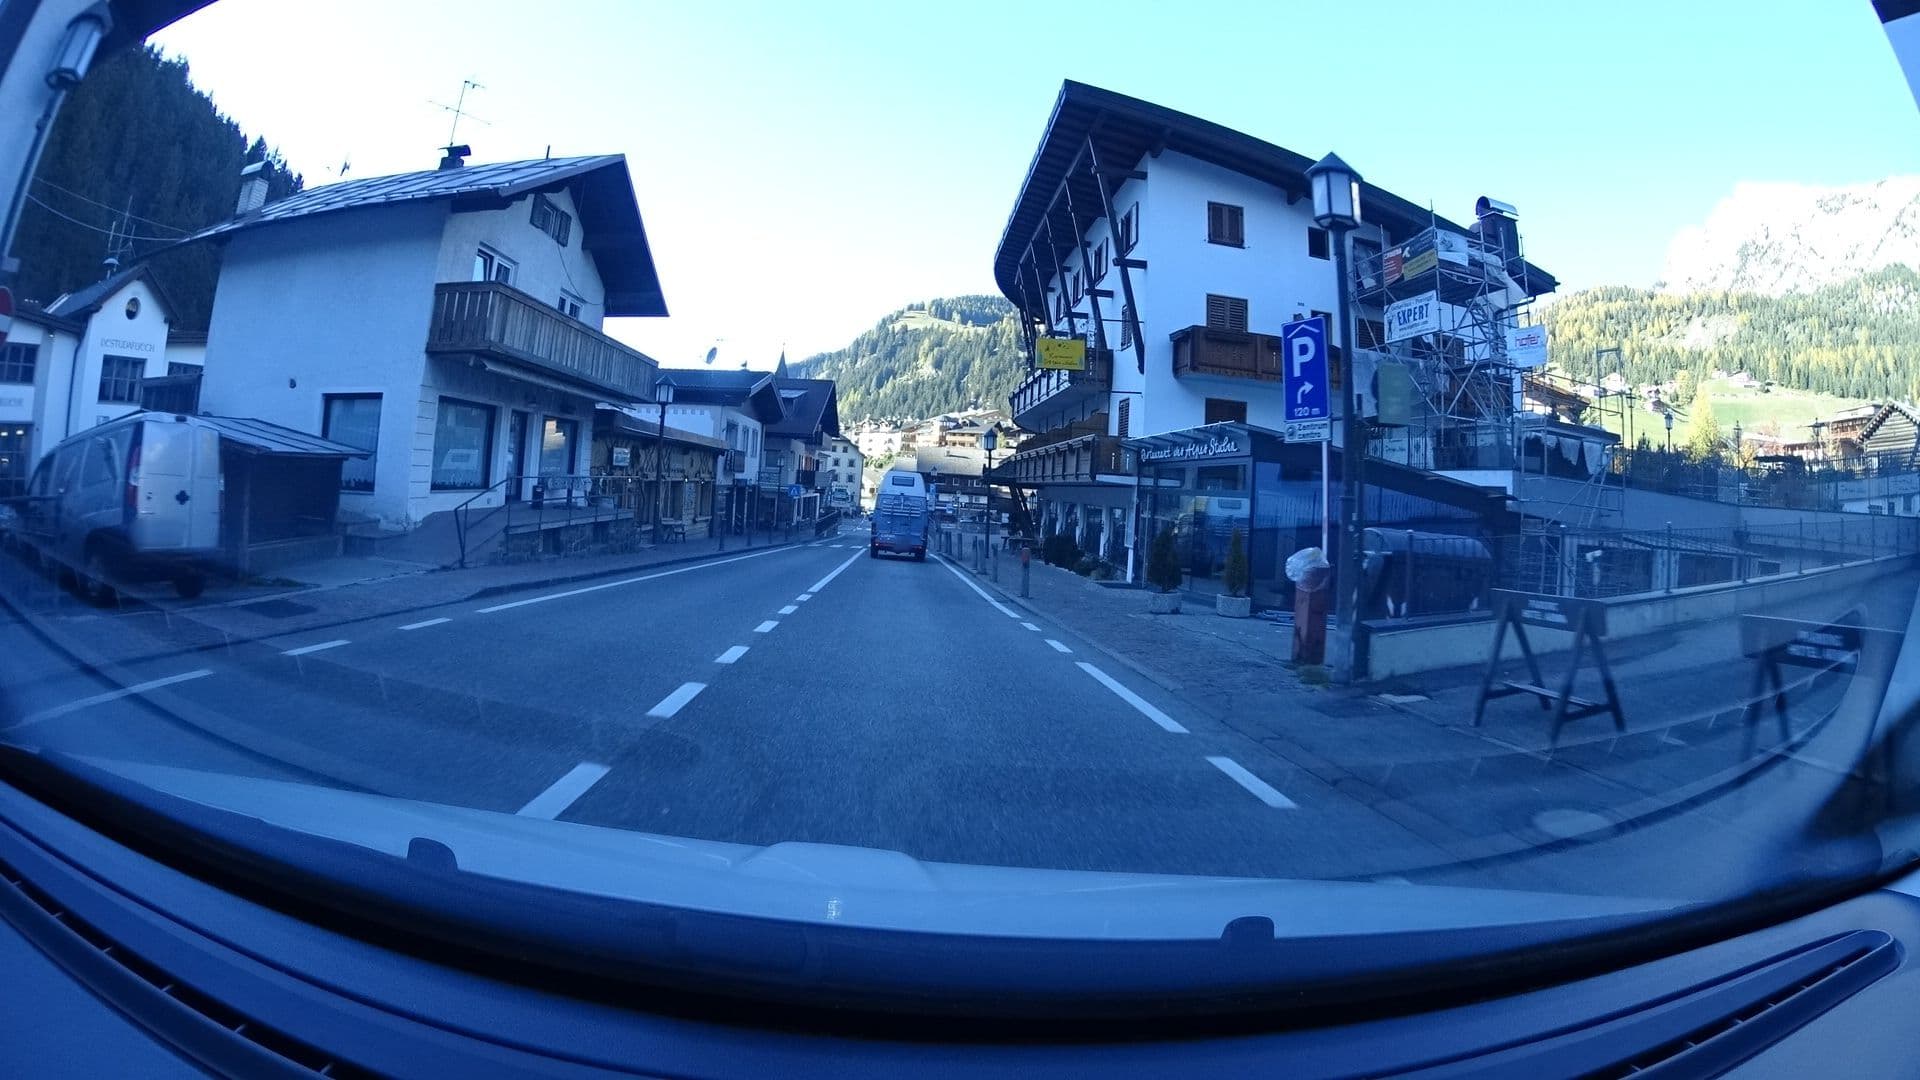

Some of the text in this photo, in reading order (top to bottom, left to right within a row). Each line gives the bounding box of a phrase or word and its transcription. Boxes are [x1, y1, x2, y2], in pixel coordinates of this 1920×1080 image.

[1397, 302, 1430, 326] EXPERT
[1292, 336, 1316, 377] P
[1294, 406, 1310, 416] 120
